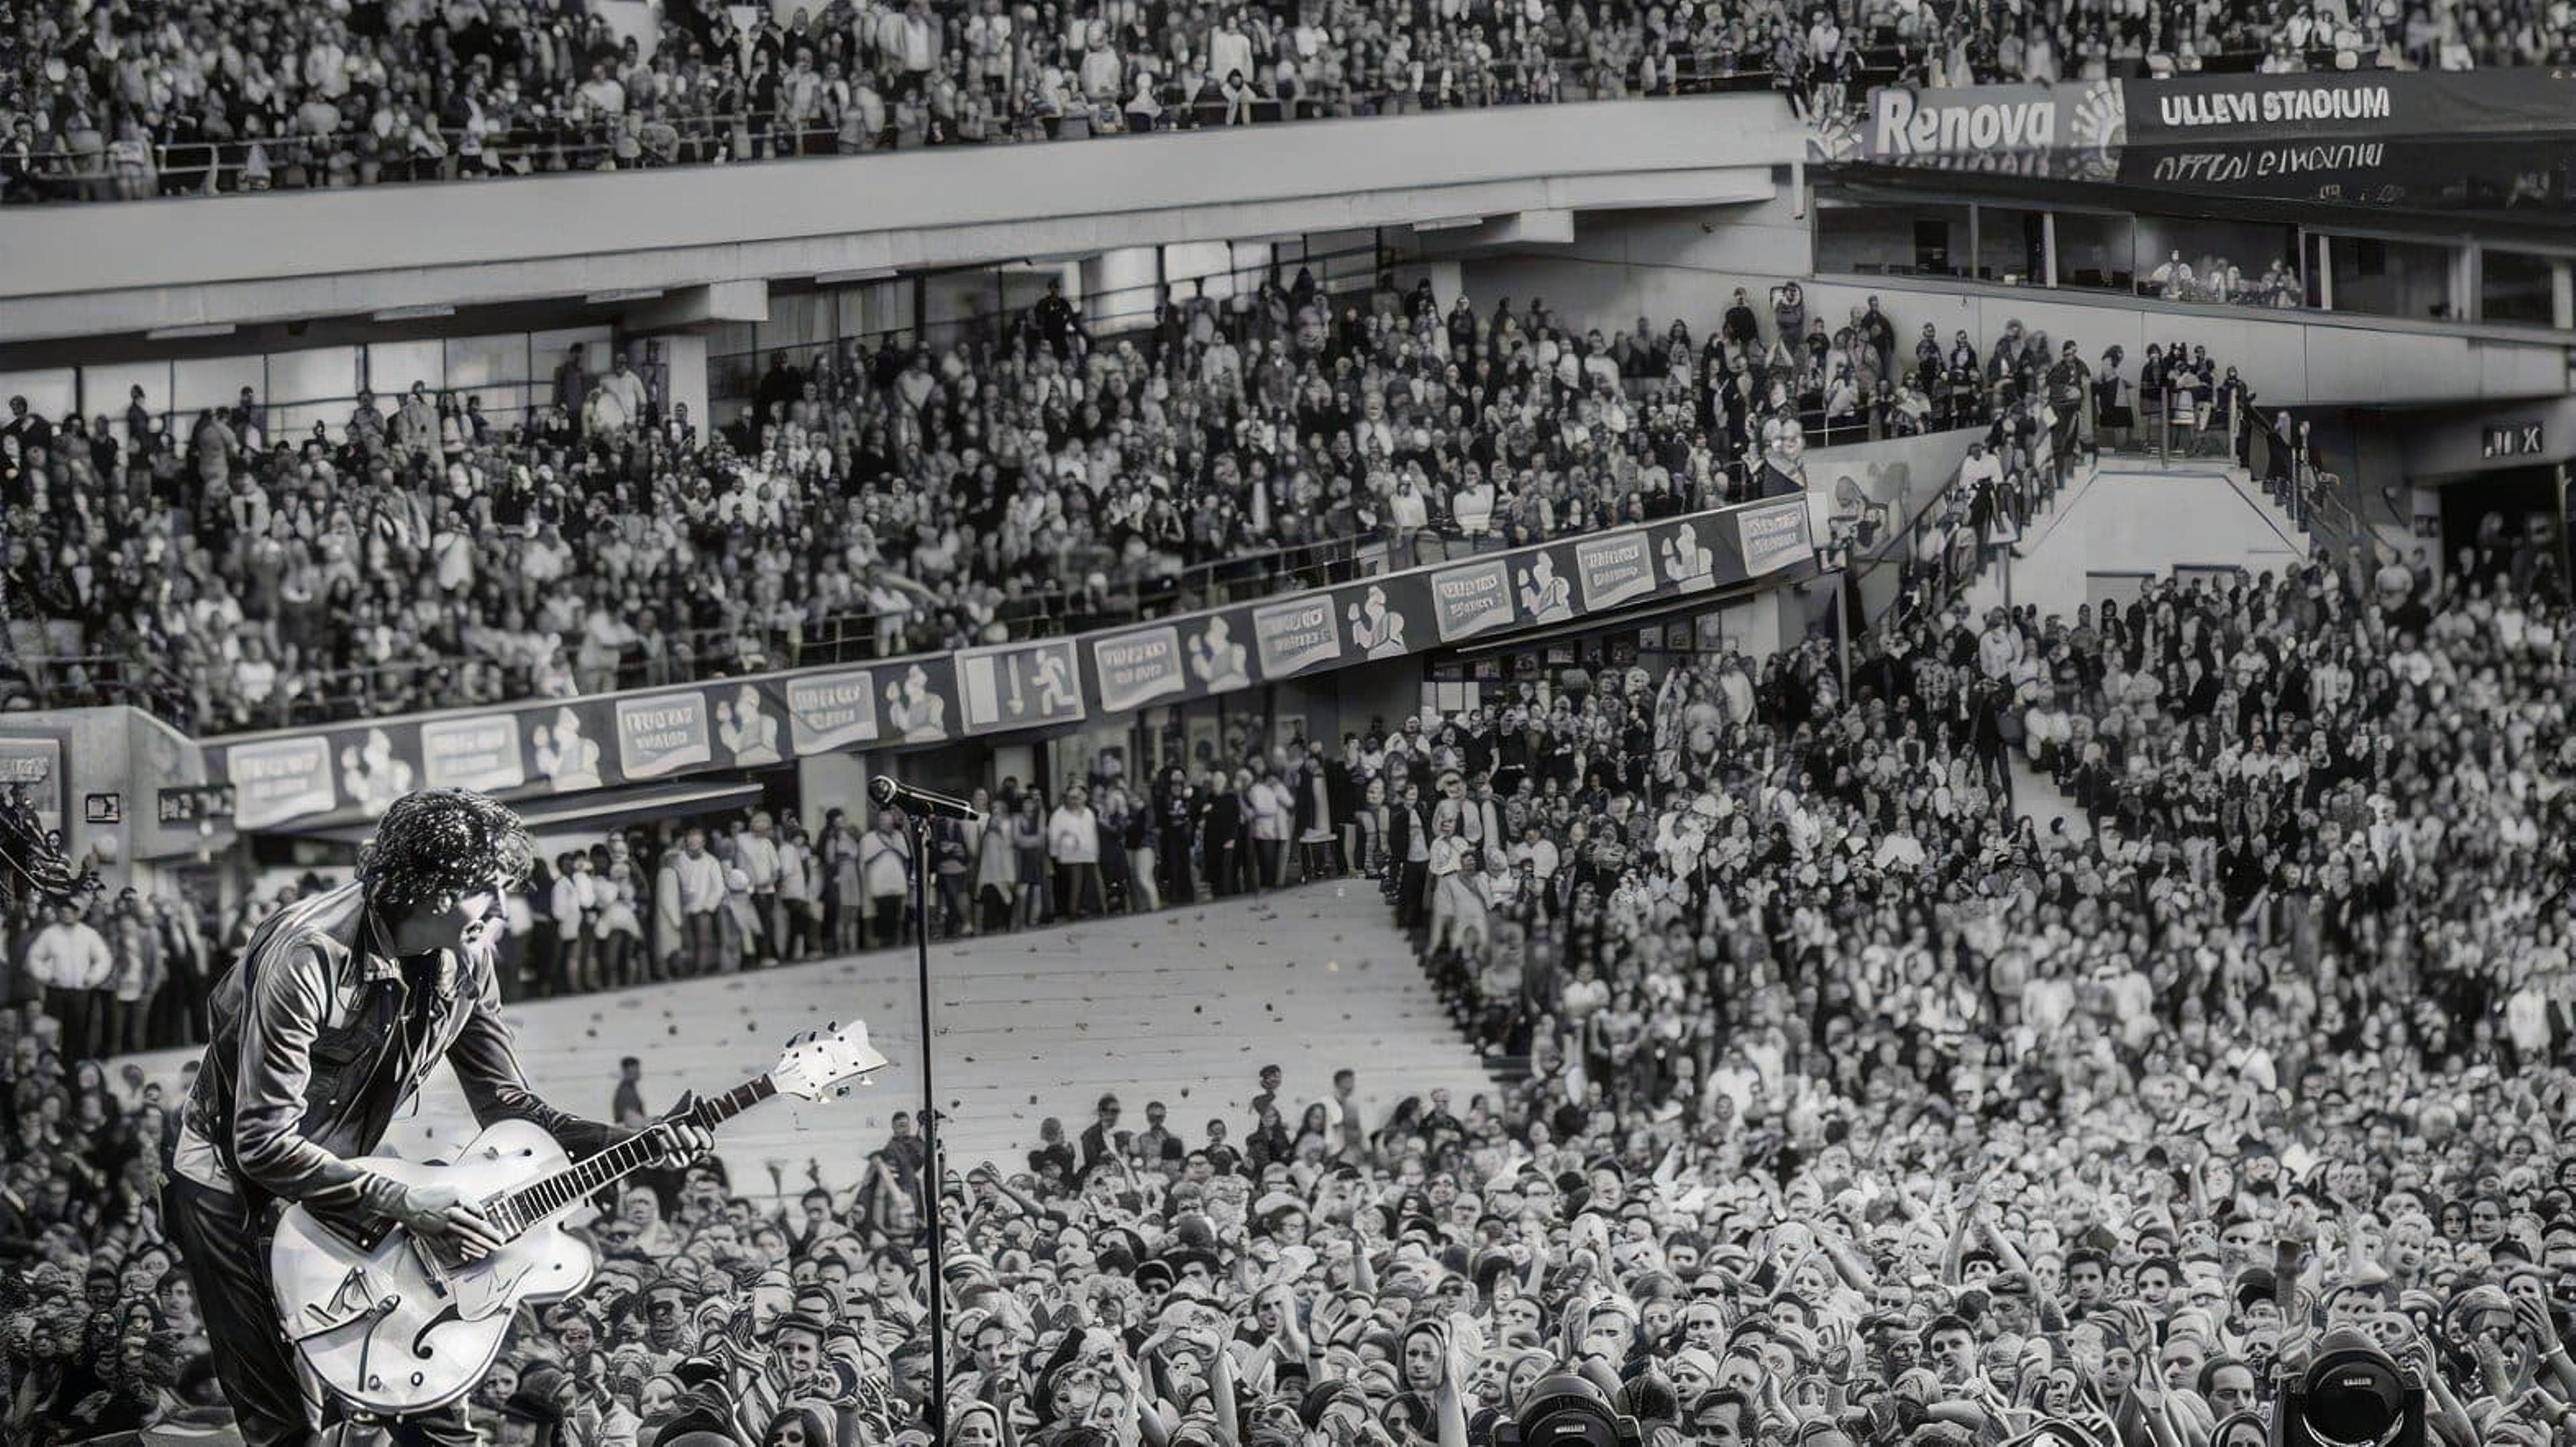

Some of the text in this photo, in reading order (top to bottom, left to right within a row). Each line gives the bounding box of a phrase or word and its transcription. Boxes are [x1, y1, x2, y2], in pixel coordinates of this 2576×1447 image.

[1876, 89, 2055, 154] Renova
[2160, 87, 2390, 126] ULLEVI STADIUM
